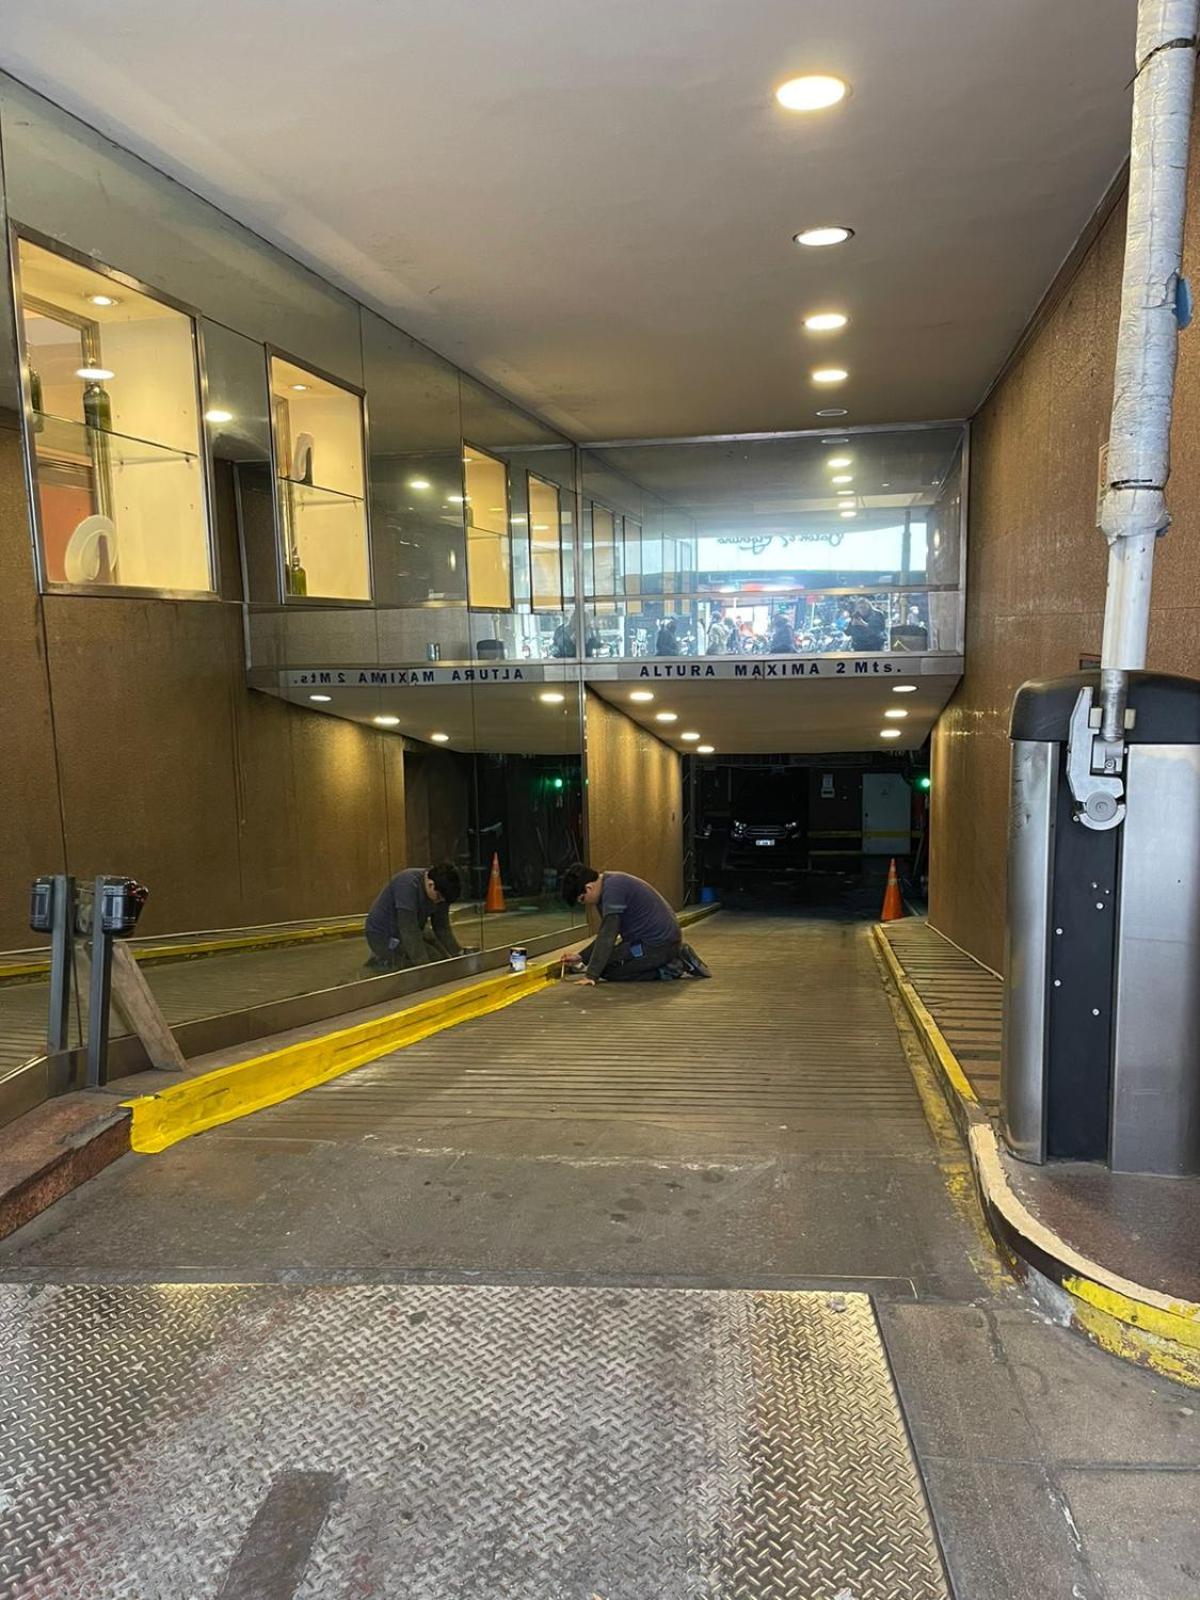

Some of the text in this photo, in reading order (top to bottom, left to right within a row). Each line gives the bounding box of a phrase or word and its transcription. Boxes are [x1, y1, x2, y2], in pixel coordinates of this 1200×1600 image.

[640, 661, 902, 677] ALTURA MAXIMA 2 Mts.
